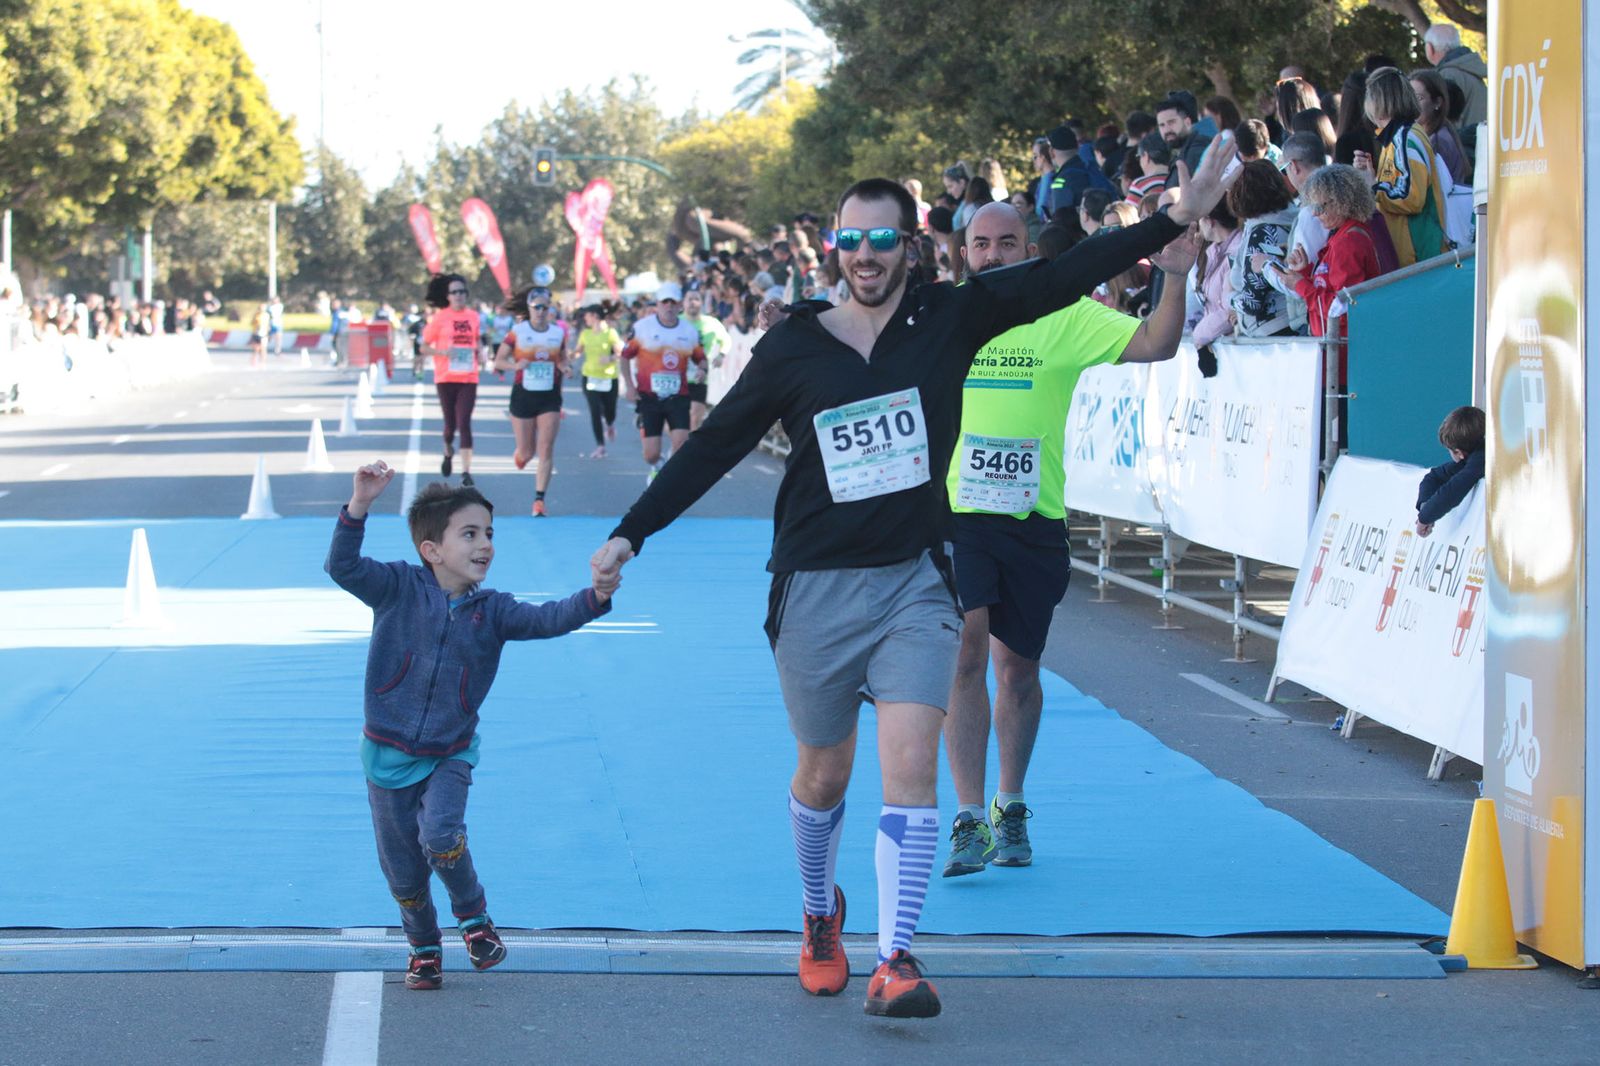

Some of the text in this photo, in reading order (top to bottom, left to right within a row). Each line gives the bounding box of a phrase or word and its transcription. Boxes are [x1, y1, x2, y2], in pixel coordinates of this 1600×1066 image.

[987, 346, 1035, 355] Maratón
[972, 356, 998, 367] ería
[998, 370, 1034, 378] ANDÚJAR
[832, 409, 916, 452] 5510
[861, 442, 893, 456] JAVI FP
[970, 448, 1033, 474] 5466
[984, 472, 1018, 481] REQUENA
